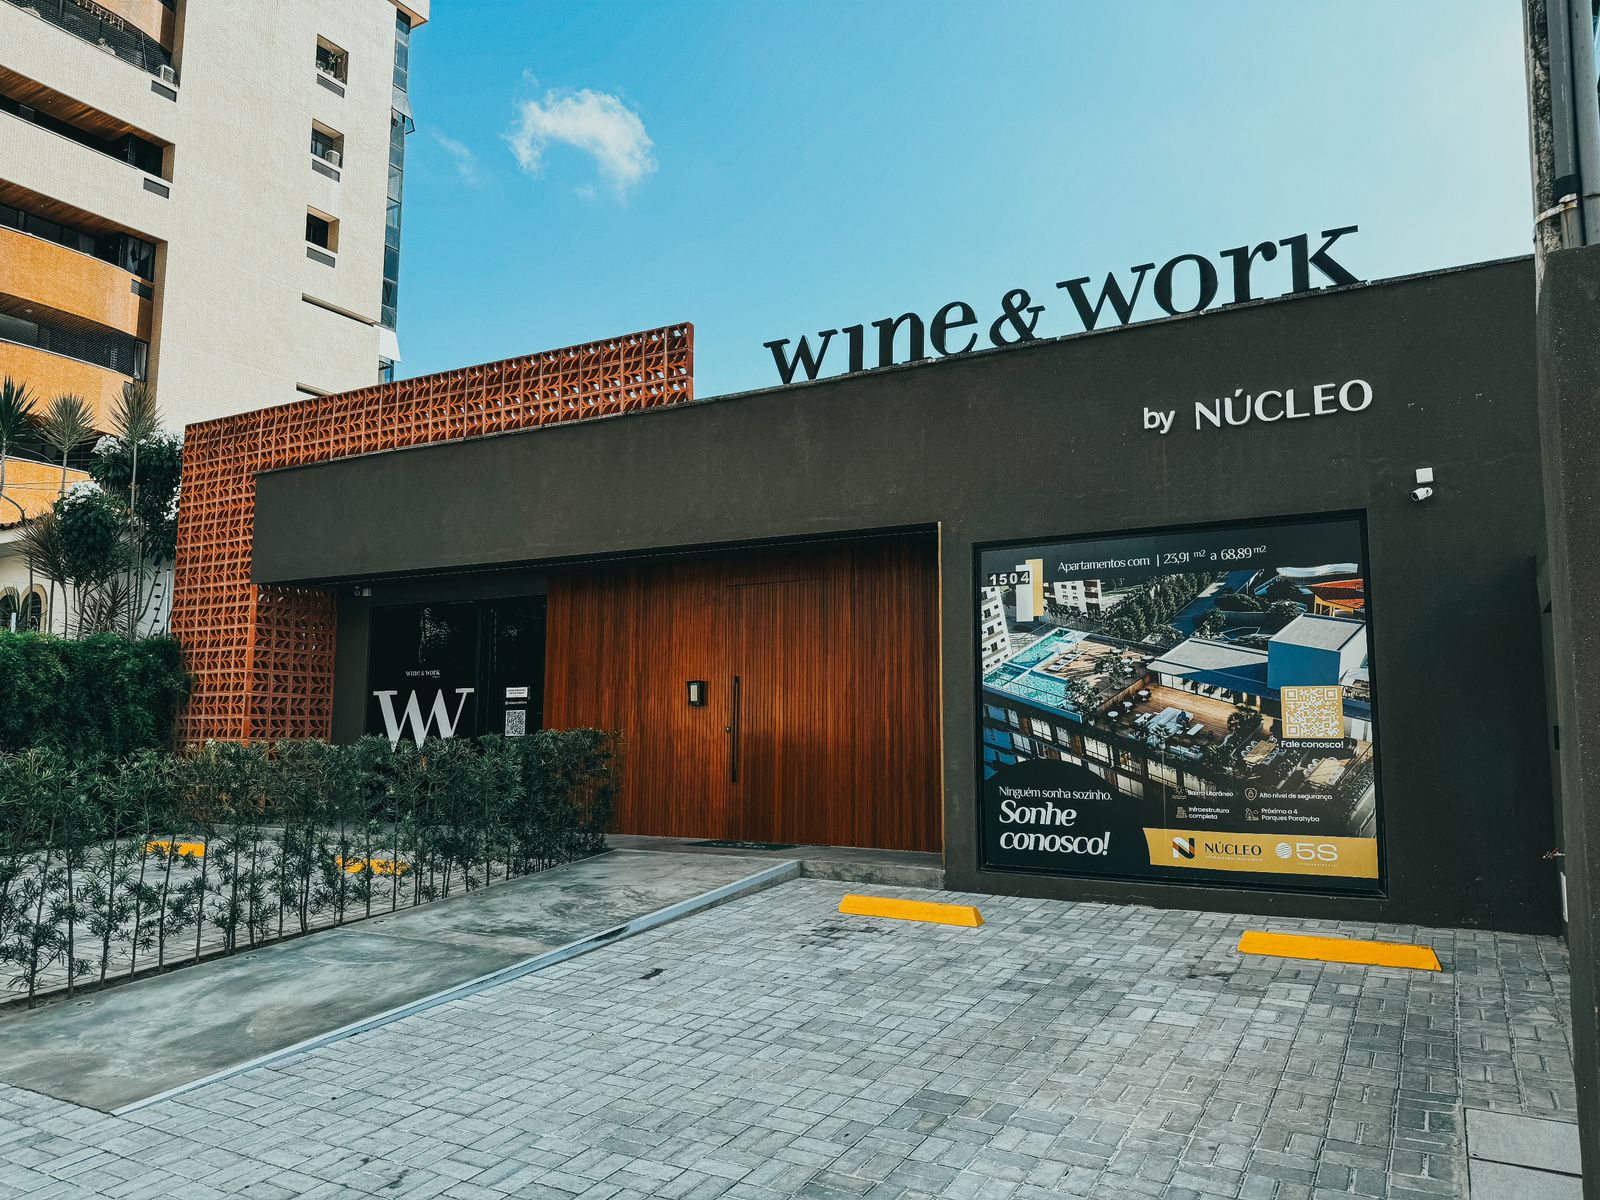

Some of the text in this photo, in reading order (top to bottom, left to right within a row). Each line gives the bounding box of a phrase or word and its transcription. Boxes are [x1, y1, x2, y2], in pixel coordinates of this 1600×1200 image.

[763, 225, 1367, 384] wine & work
[1143, 379, 1373, 434] by NÚCLEO
[1058, 555, 1126, 573] Apartamentos
[1127, 557, 1150, 567] com
[1163, 552, 1190, 565] 23,91
[1210, 551, 1217, 560] a
[1220, 547, 1252, 560] 68,89
[989, 571, 1030, 586] 1504
[1281, 740, 1344, 749] Fale conosco!
[999, 786, 1112, 801] Ninguém sonha sozinho.
[999, 799, 1077, 827] Sonhe
[1188, 806, 1230, 814] Infraestrutura
[1188, 813, 1218, 821] completa
[1261, 815, 1320, 824] Parques Parahyba
[1000, 831, 1111, 856] conosco!
[1204, 841, 1262, 856] NÚCLEO
[1296, 843, 1339, 862] 5S
